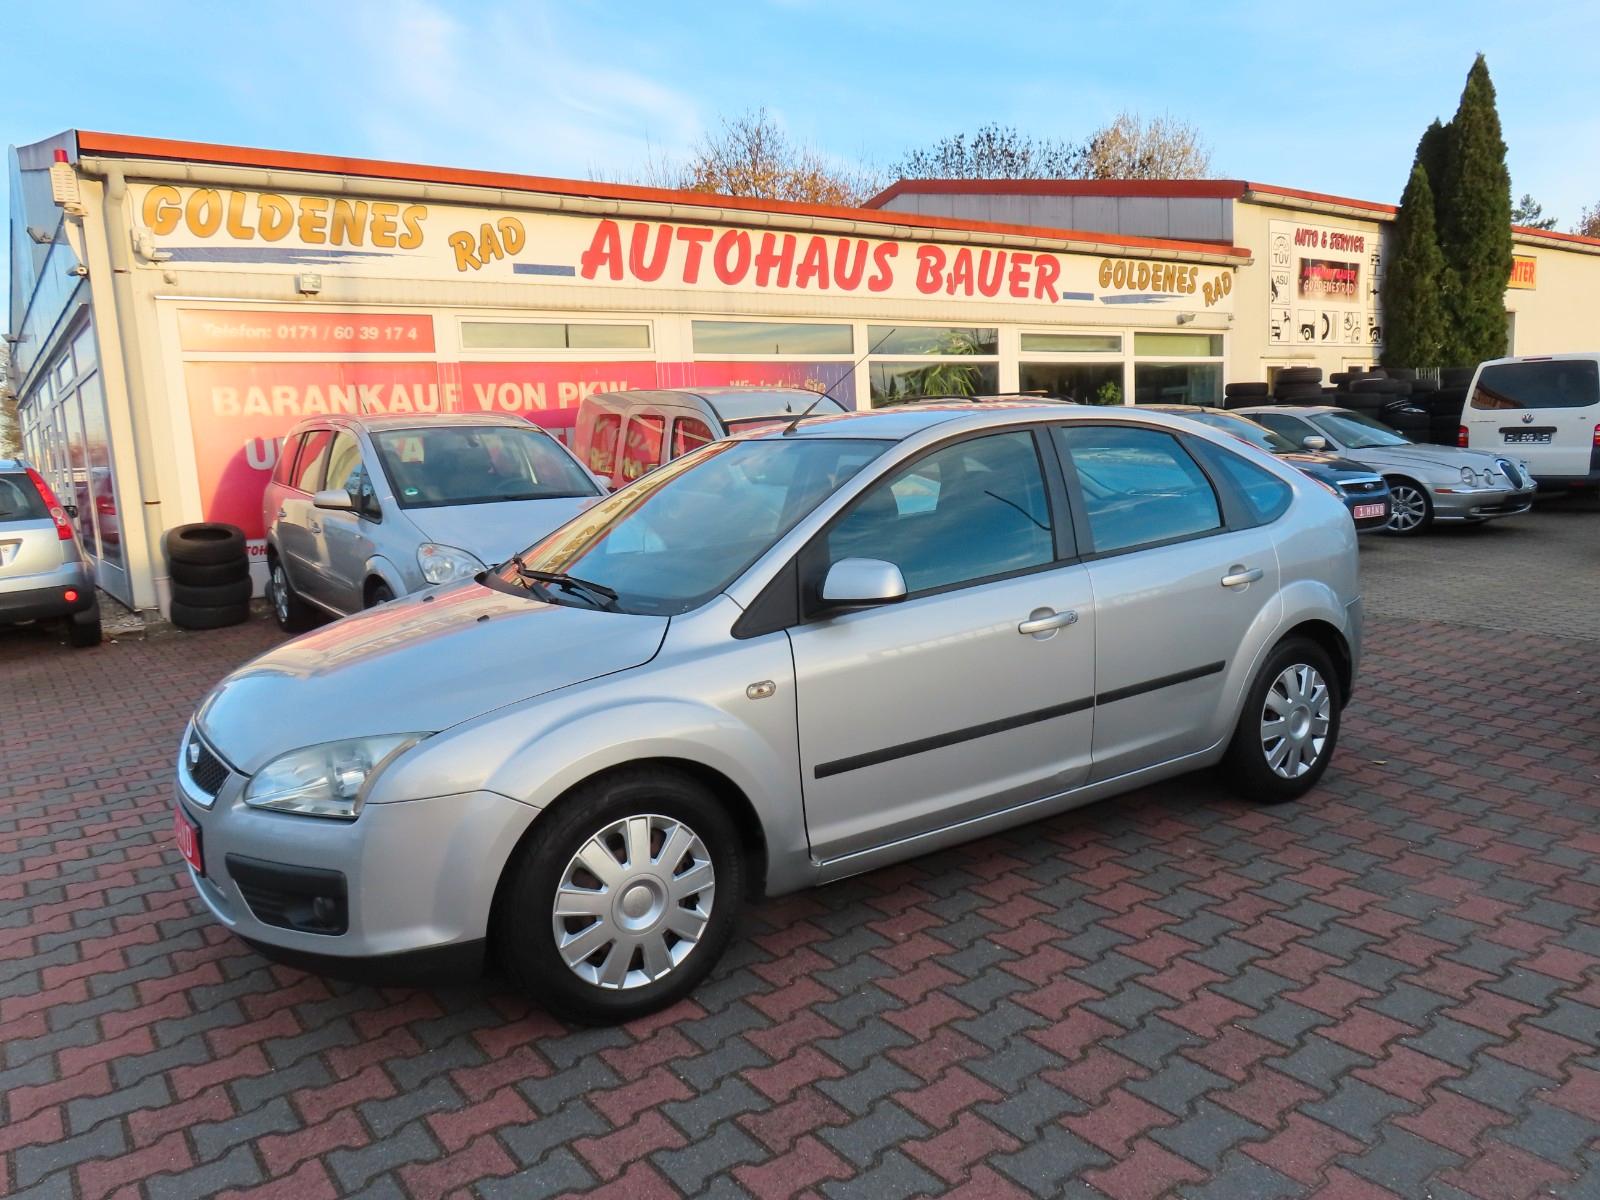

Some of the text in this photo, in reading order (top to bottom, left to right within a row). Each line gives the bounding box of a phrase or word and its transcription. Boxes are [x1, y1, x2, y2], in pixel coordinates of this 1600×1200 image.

[141, 184, 526, 272] GOLDENES RAD
[1295, 228, 1318, 247] AUTO
[1330, 232, 1364, 253] SERVICE
[580, 219, 1061, 304] AUTOHAUS BAUER
[1273, 252, 1289, 264] TÜV
[1099, 258, 1232, 308] GOLDENES RAD
[1275, 275, 1288, 285] ASU
[1303, 279, 1340, 293] GOLDENES
[277, 325, 318, 340] 0171
[333, 326, 354, 340] 60
[359, 327, 379, 340] 39
[211, 383, 458, 416] BARANKAUF
[473, 382, 548, 412] VON
